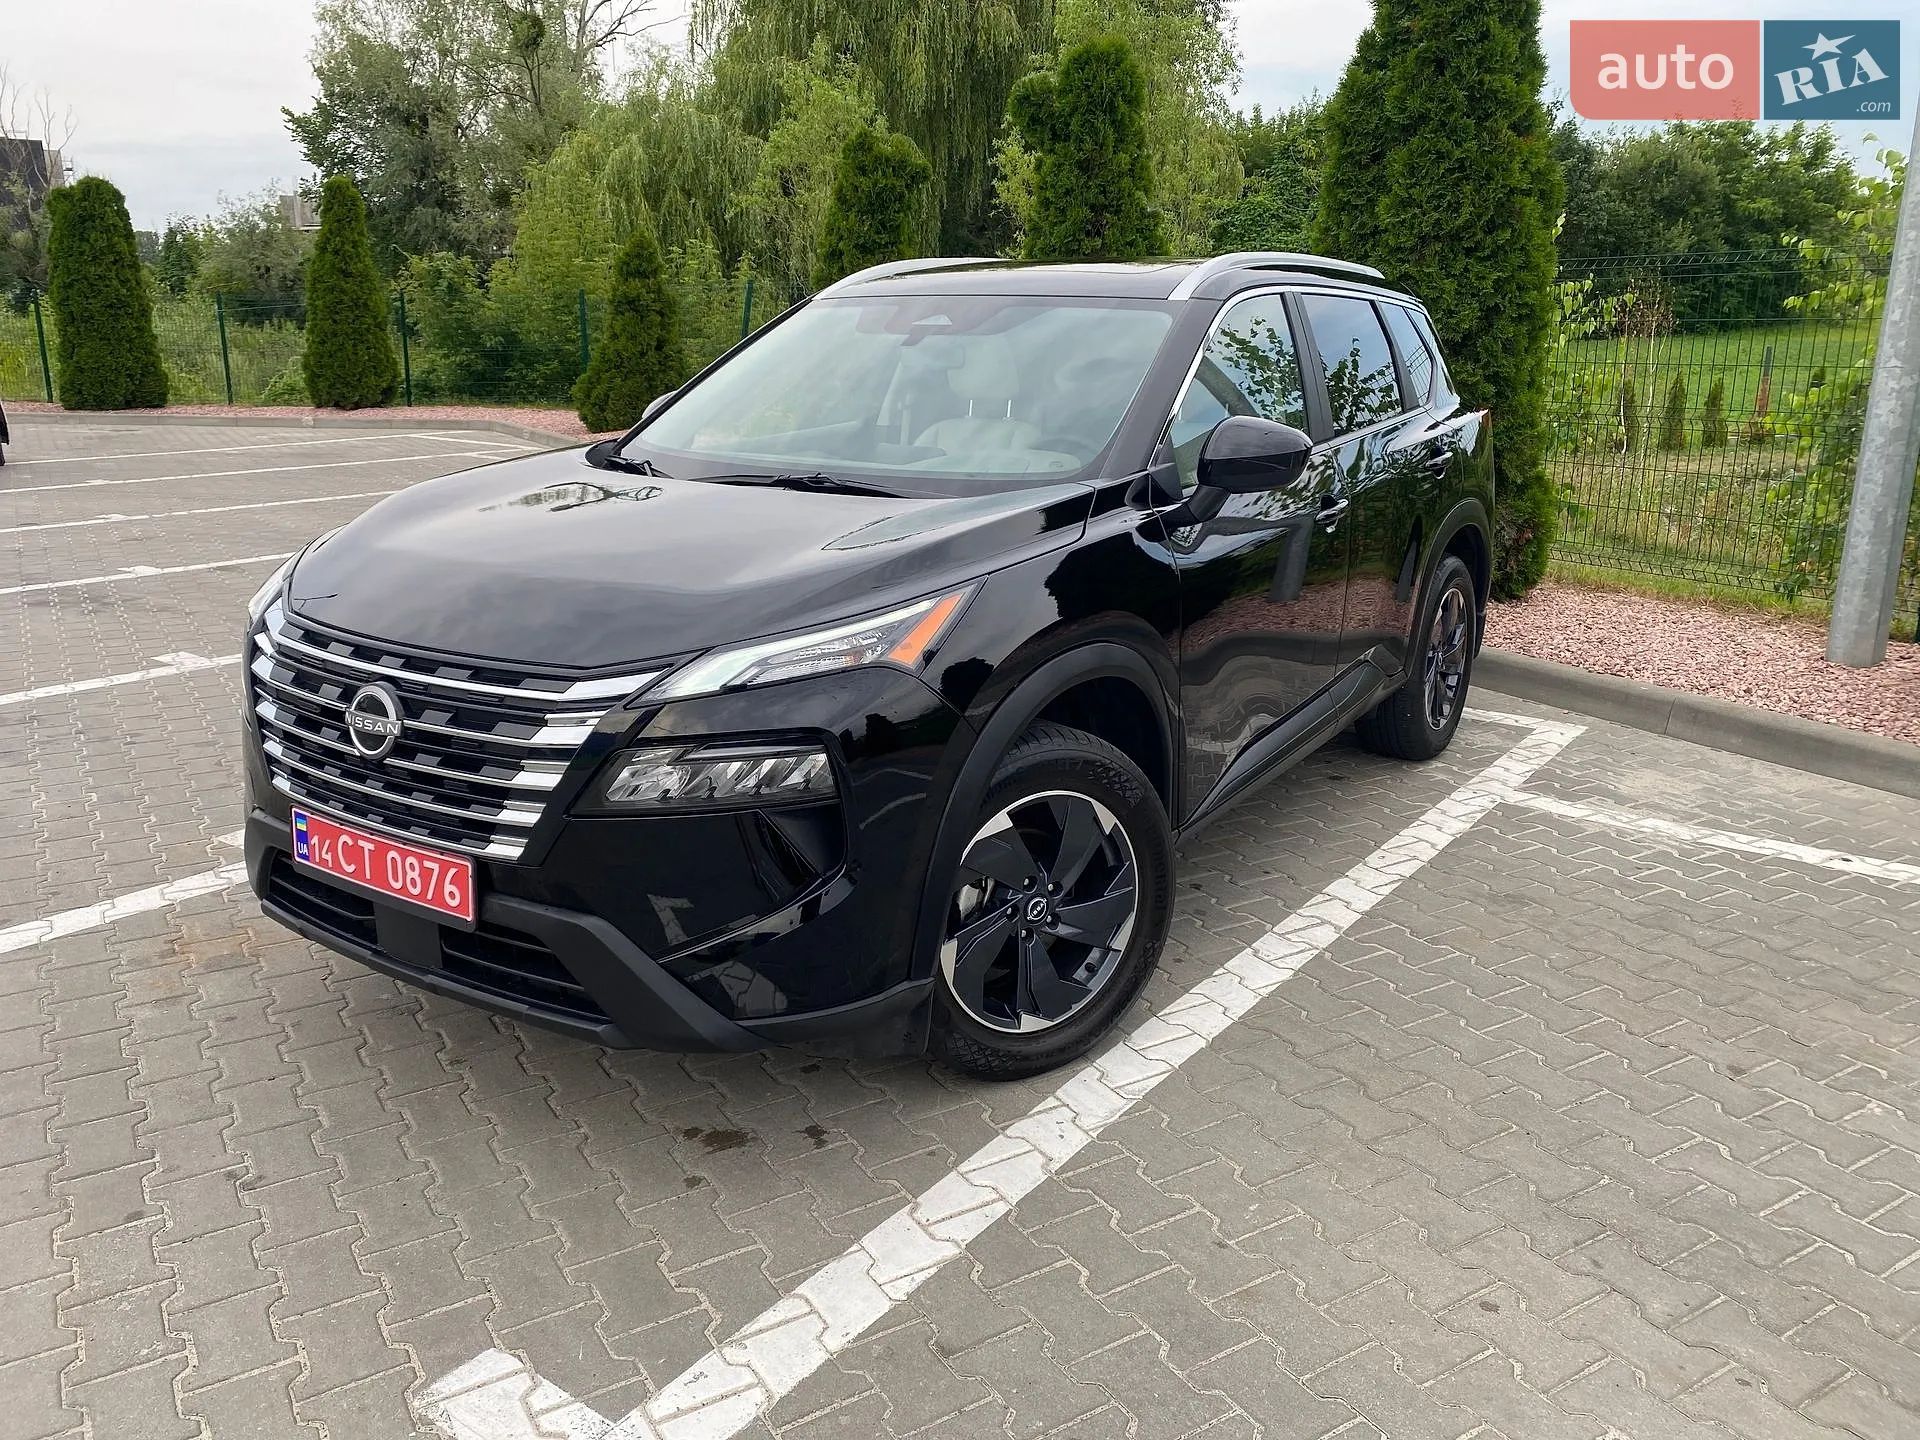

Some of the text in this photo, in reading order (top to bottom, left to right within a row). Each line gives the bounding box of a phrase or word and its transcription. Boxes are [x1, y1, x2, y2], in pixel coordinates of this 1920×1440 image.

[345, 710, 399, 735] NISSAN
[297, 842, 309, 856] UA
[385, 850, 462, 909] 0876
